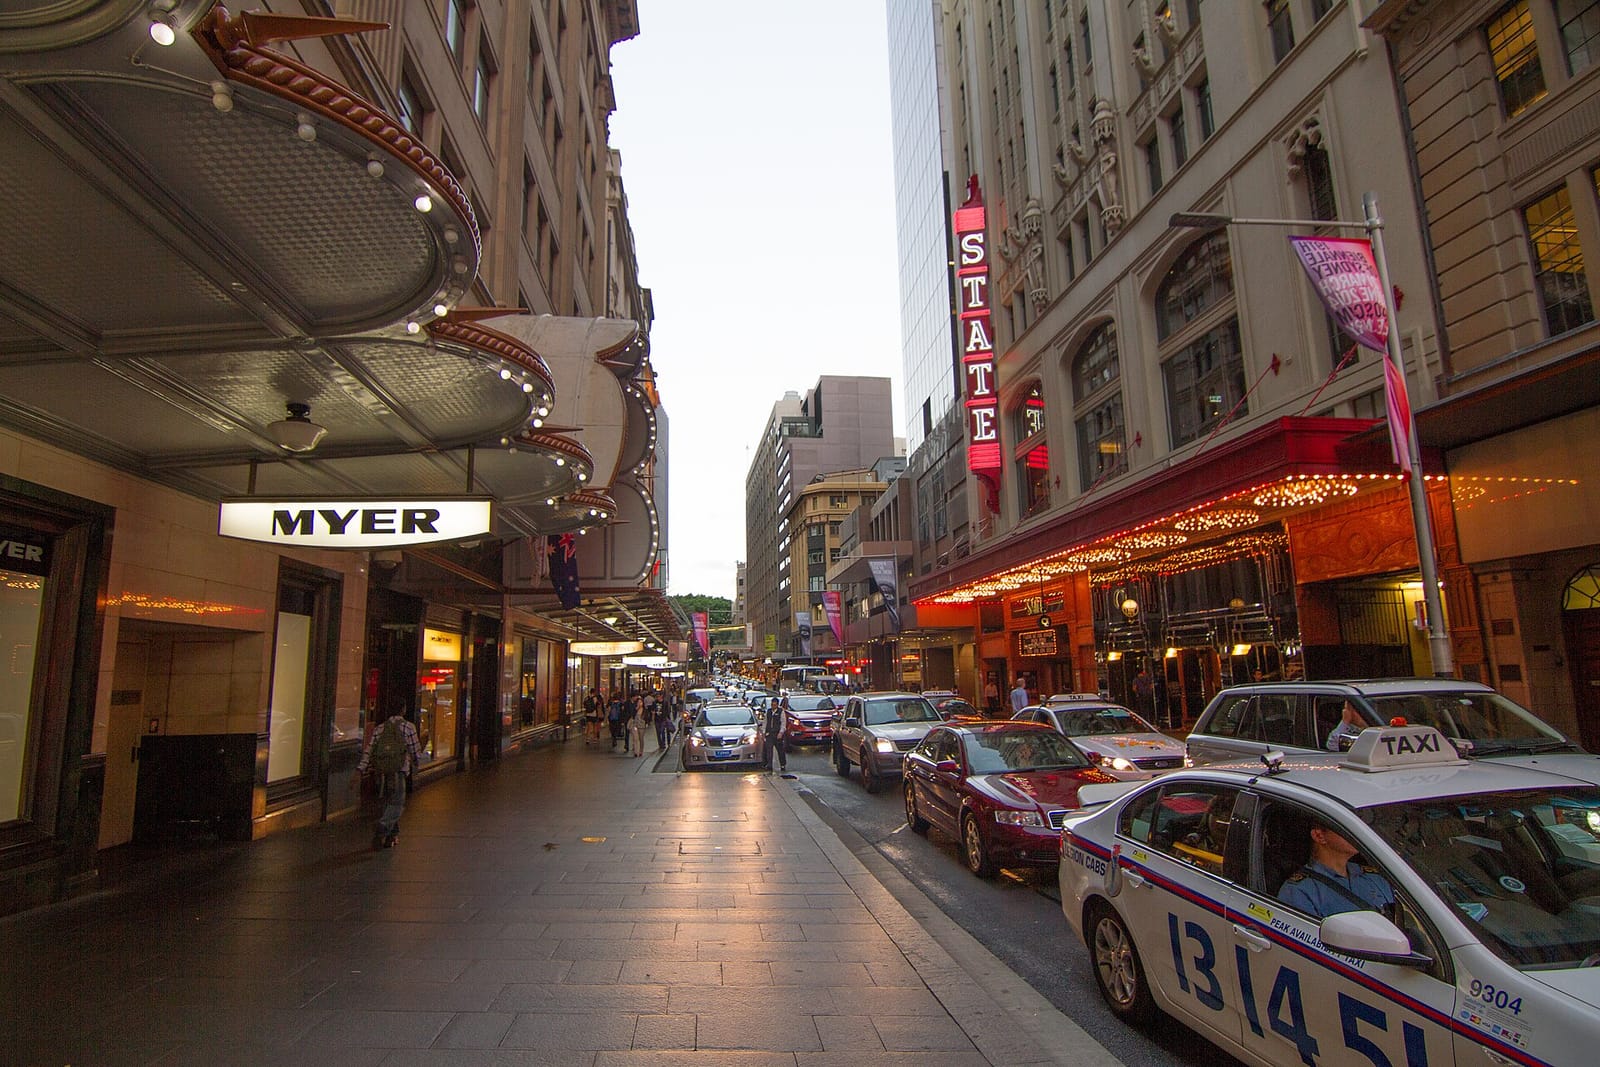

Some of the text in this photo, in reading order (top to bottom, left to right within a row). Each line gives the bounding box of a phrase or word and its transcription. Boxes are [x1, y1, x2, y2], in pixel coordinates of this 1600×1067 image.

[960, 232, 996, 442] STATE
[271, 507, 442, 536] MYER
[1381, 733, 1441, 756] TAXI
[1085, 855, 1106, 876] CABS
[1270, 917, 1290, 934] PEAK
[1469, 979, 1523, 1016] 9304
